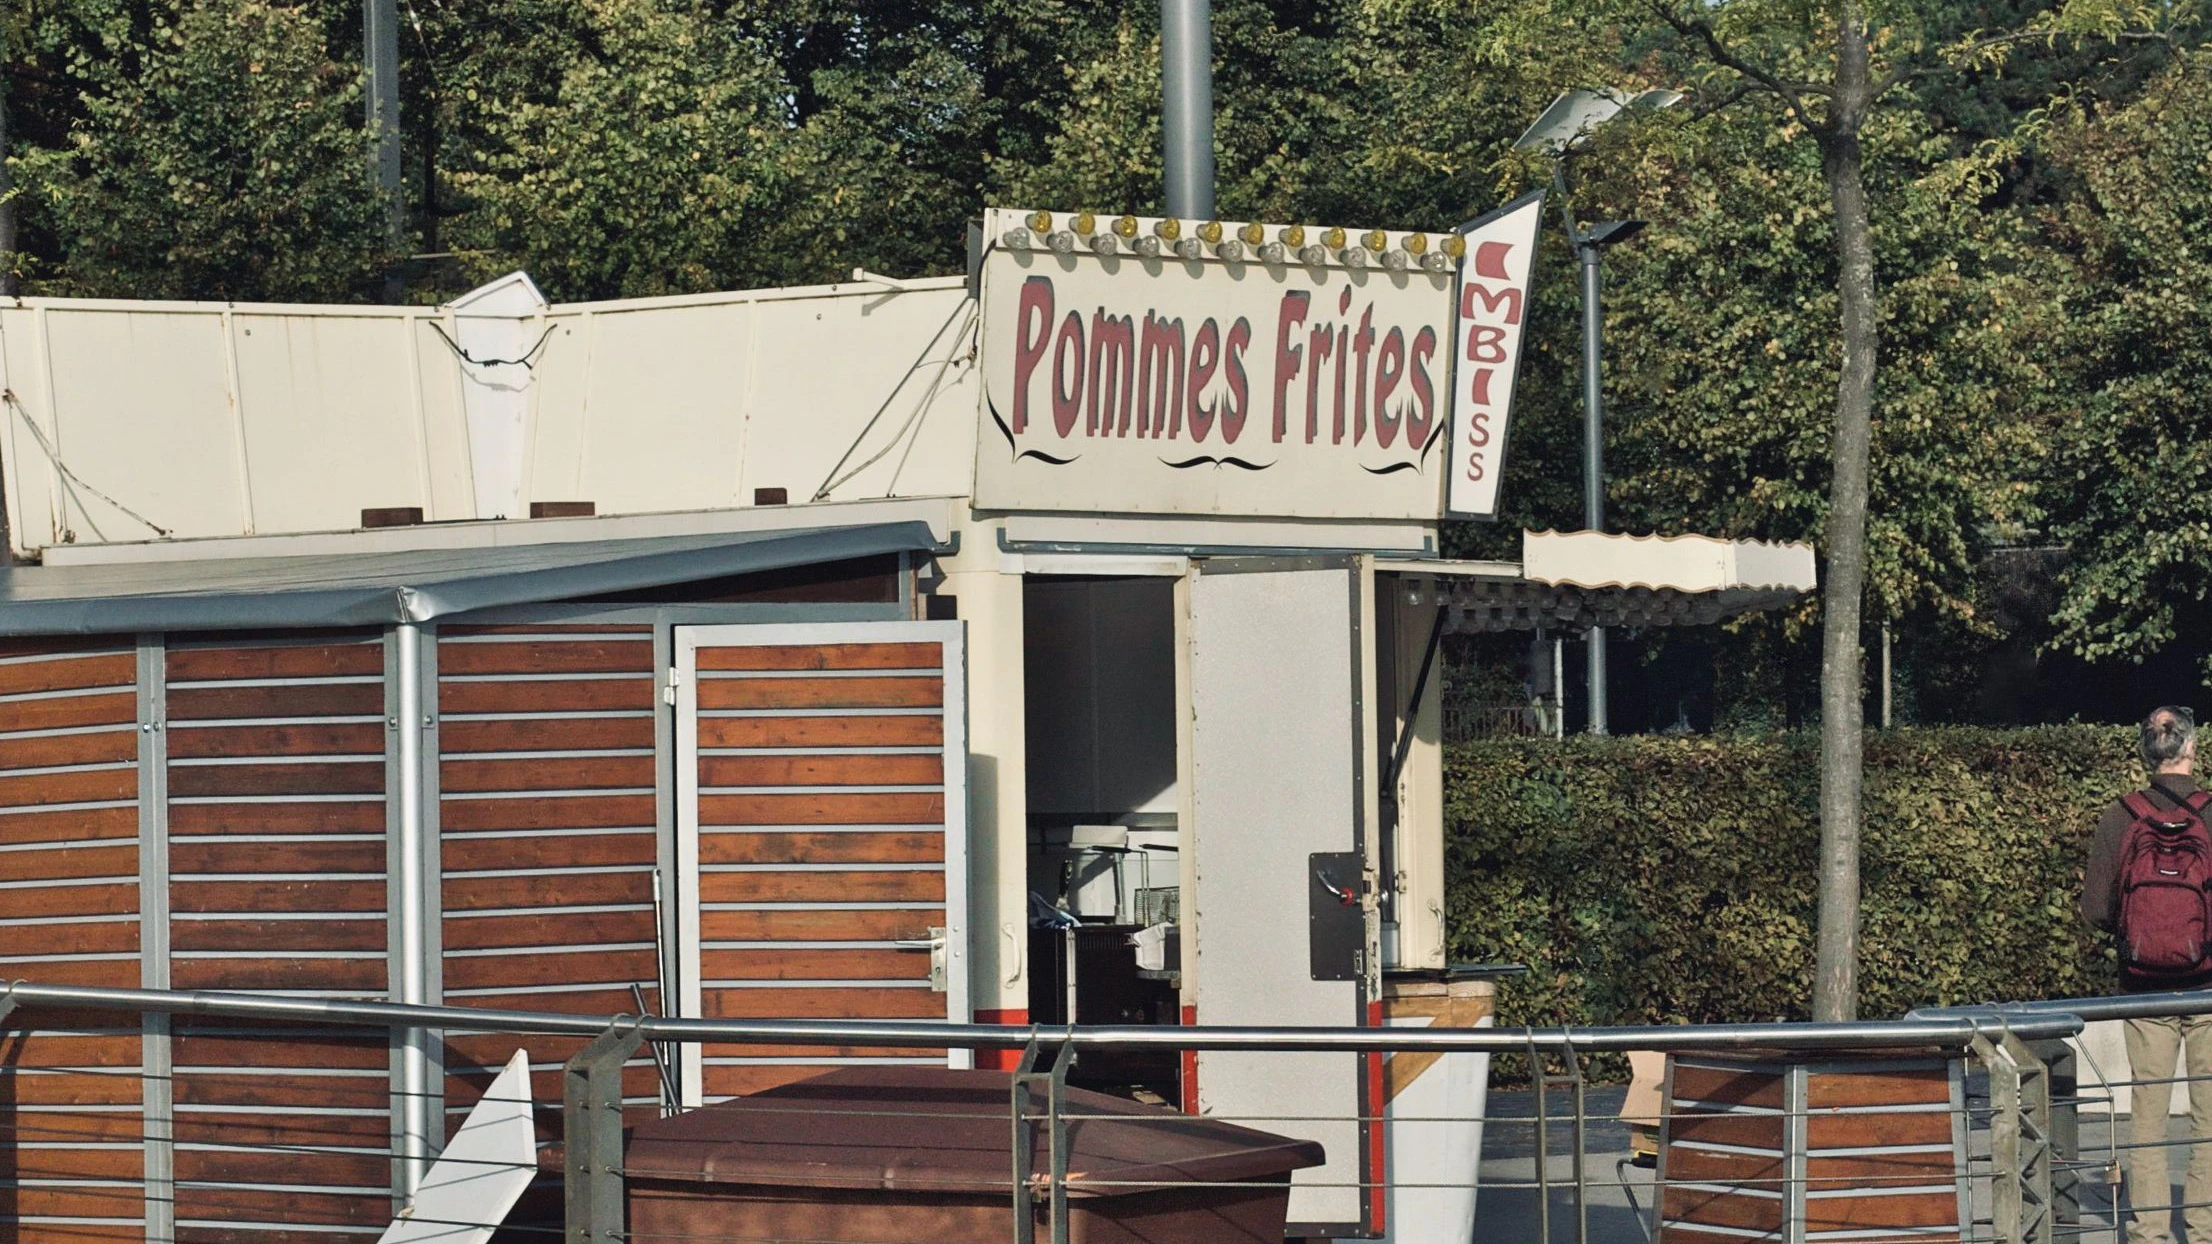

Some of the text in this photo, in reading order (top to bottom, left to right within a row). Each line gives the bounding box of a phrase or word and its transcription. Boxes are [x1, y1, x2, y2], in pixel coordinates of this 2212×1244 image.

[1012, 275, 1437, 450] Pommes Frites
[1461, 240, 1522, 481] IMBISS
